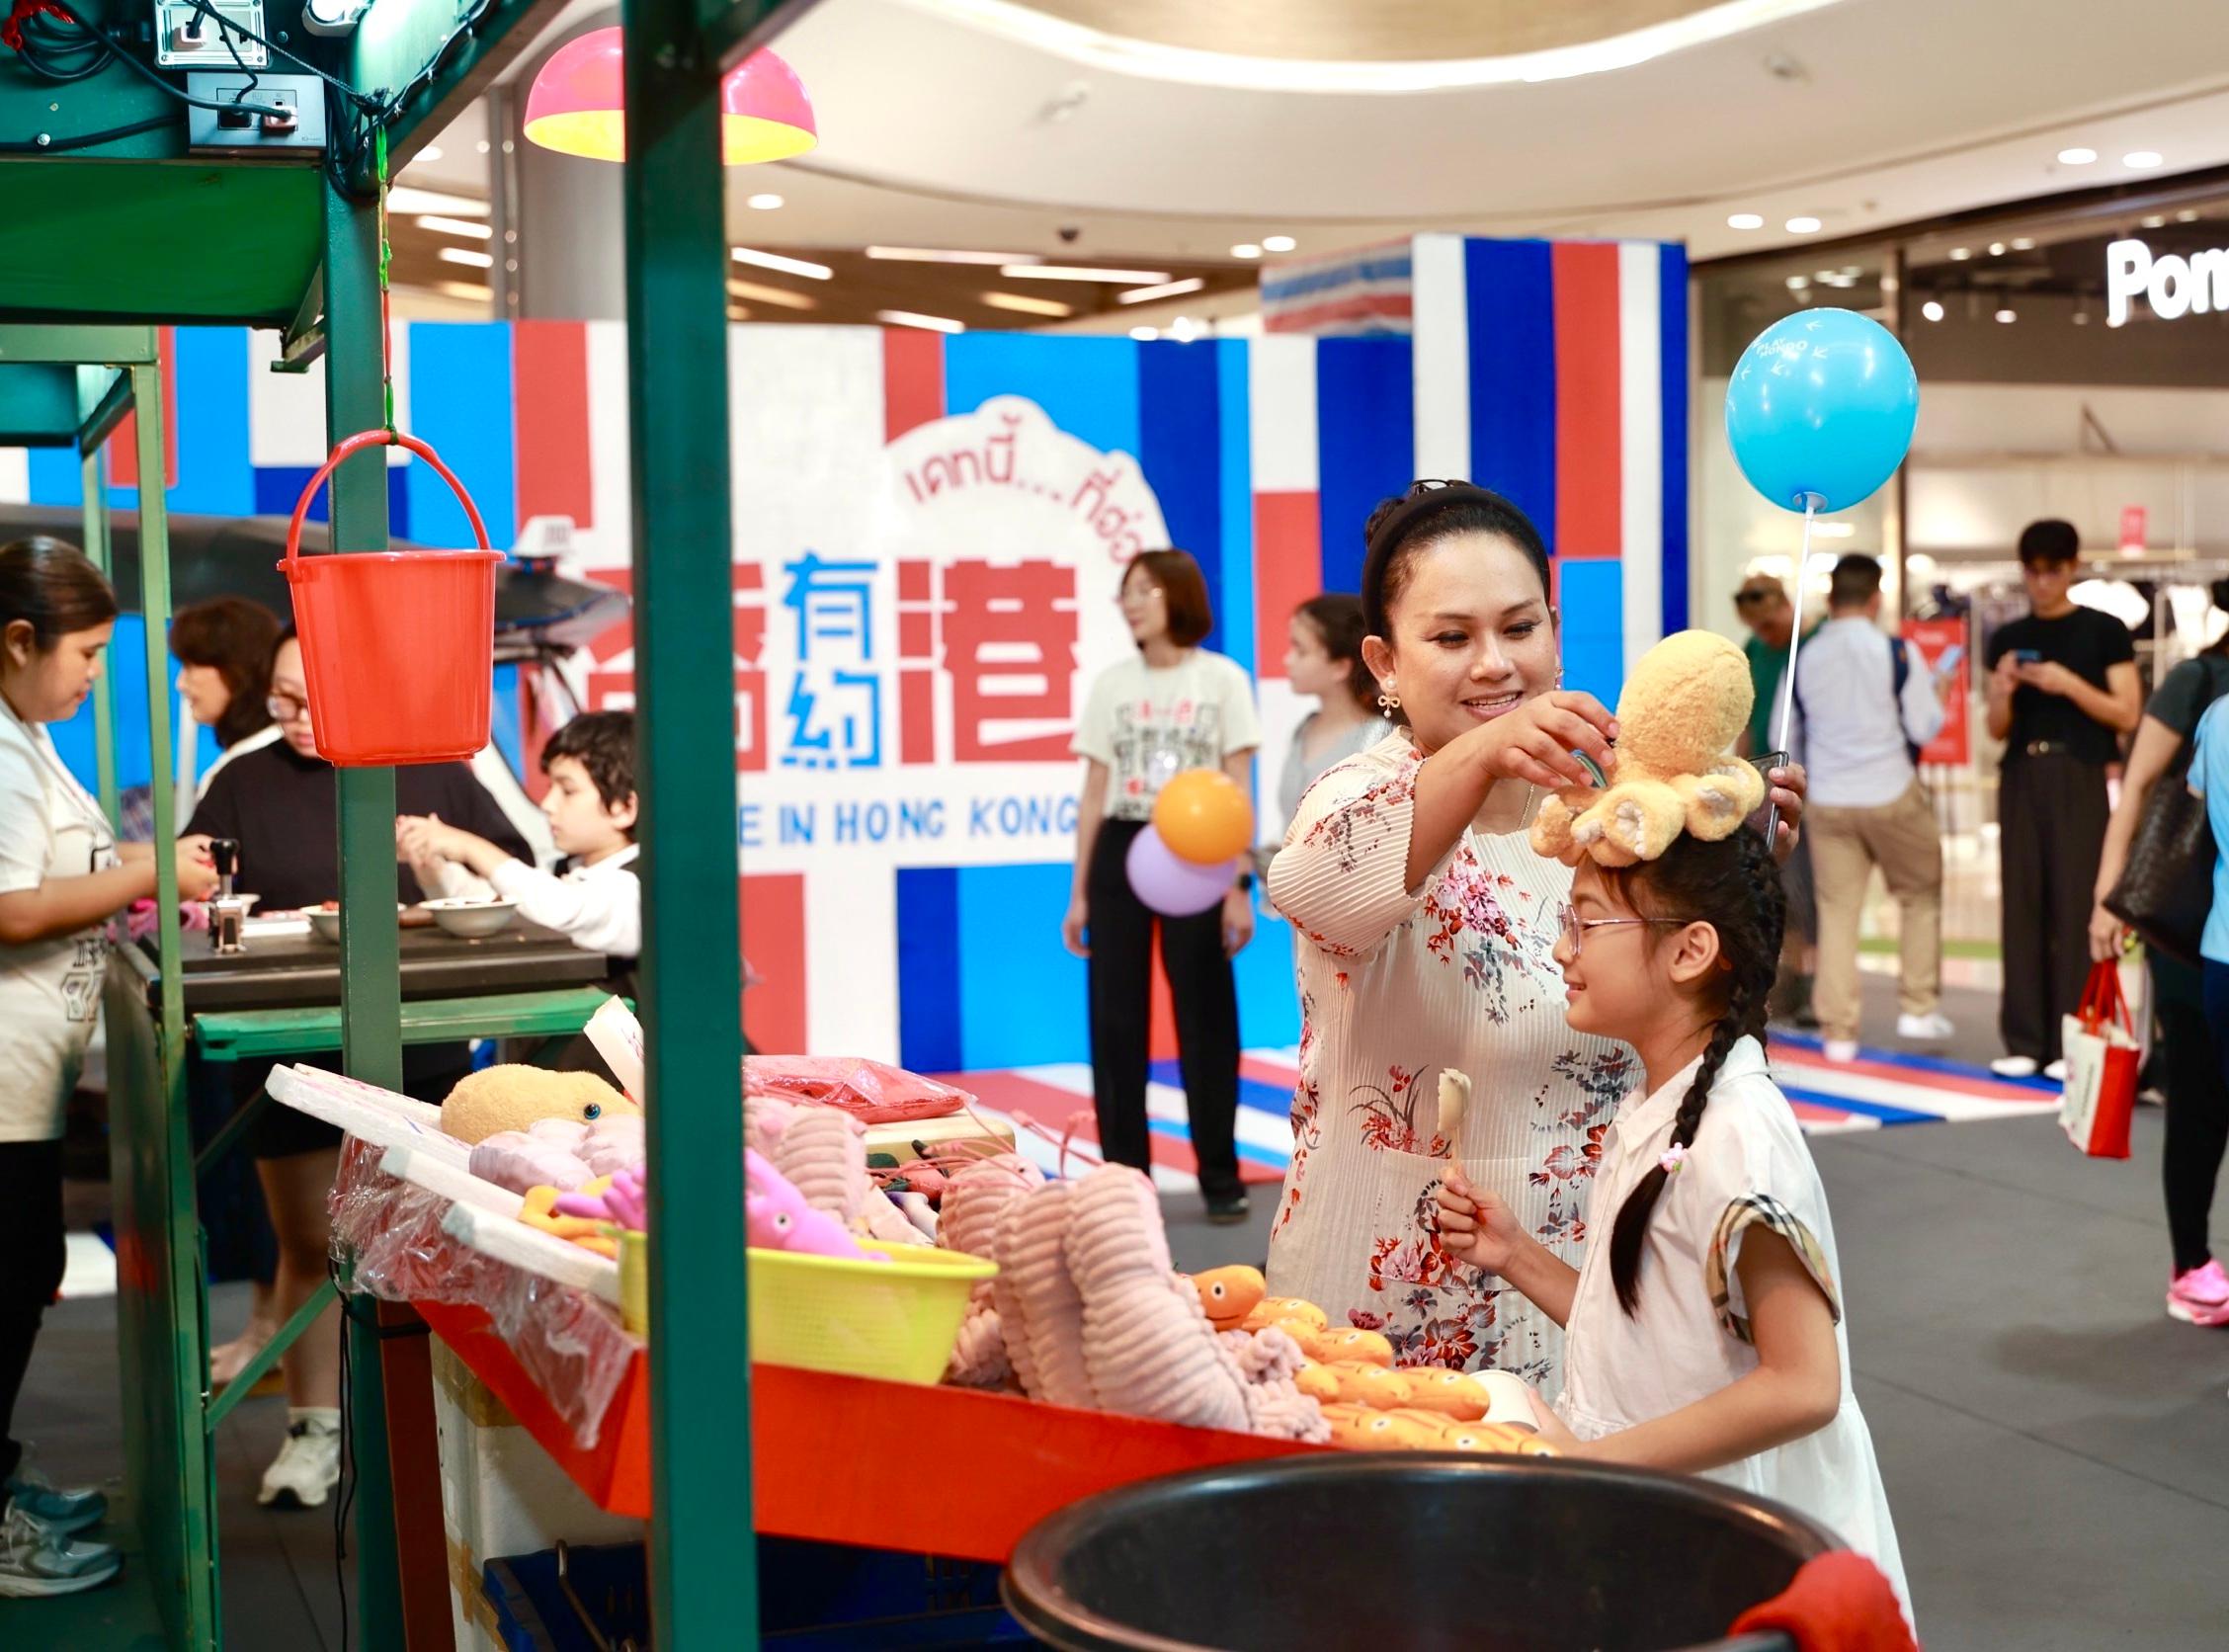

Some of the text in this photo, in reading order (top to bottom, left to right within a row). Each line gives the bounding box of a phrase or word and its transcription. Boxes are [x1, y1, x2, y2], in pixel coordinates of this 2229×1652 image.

[780, 805, 815, 845] IN
[835, 801, 946, 844] HONG
[968, 795, 1081, 837] KONG
